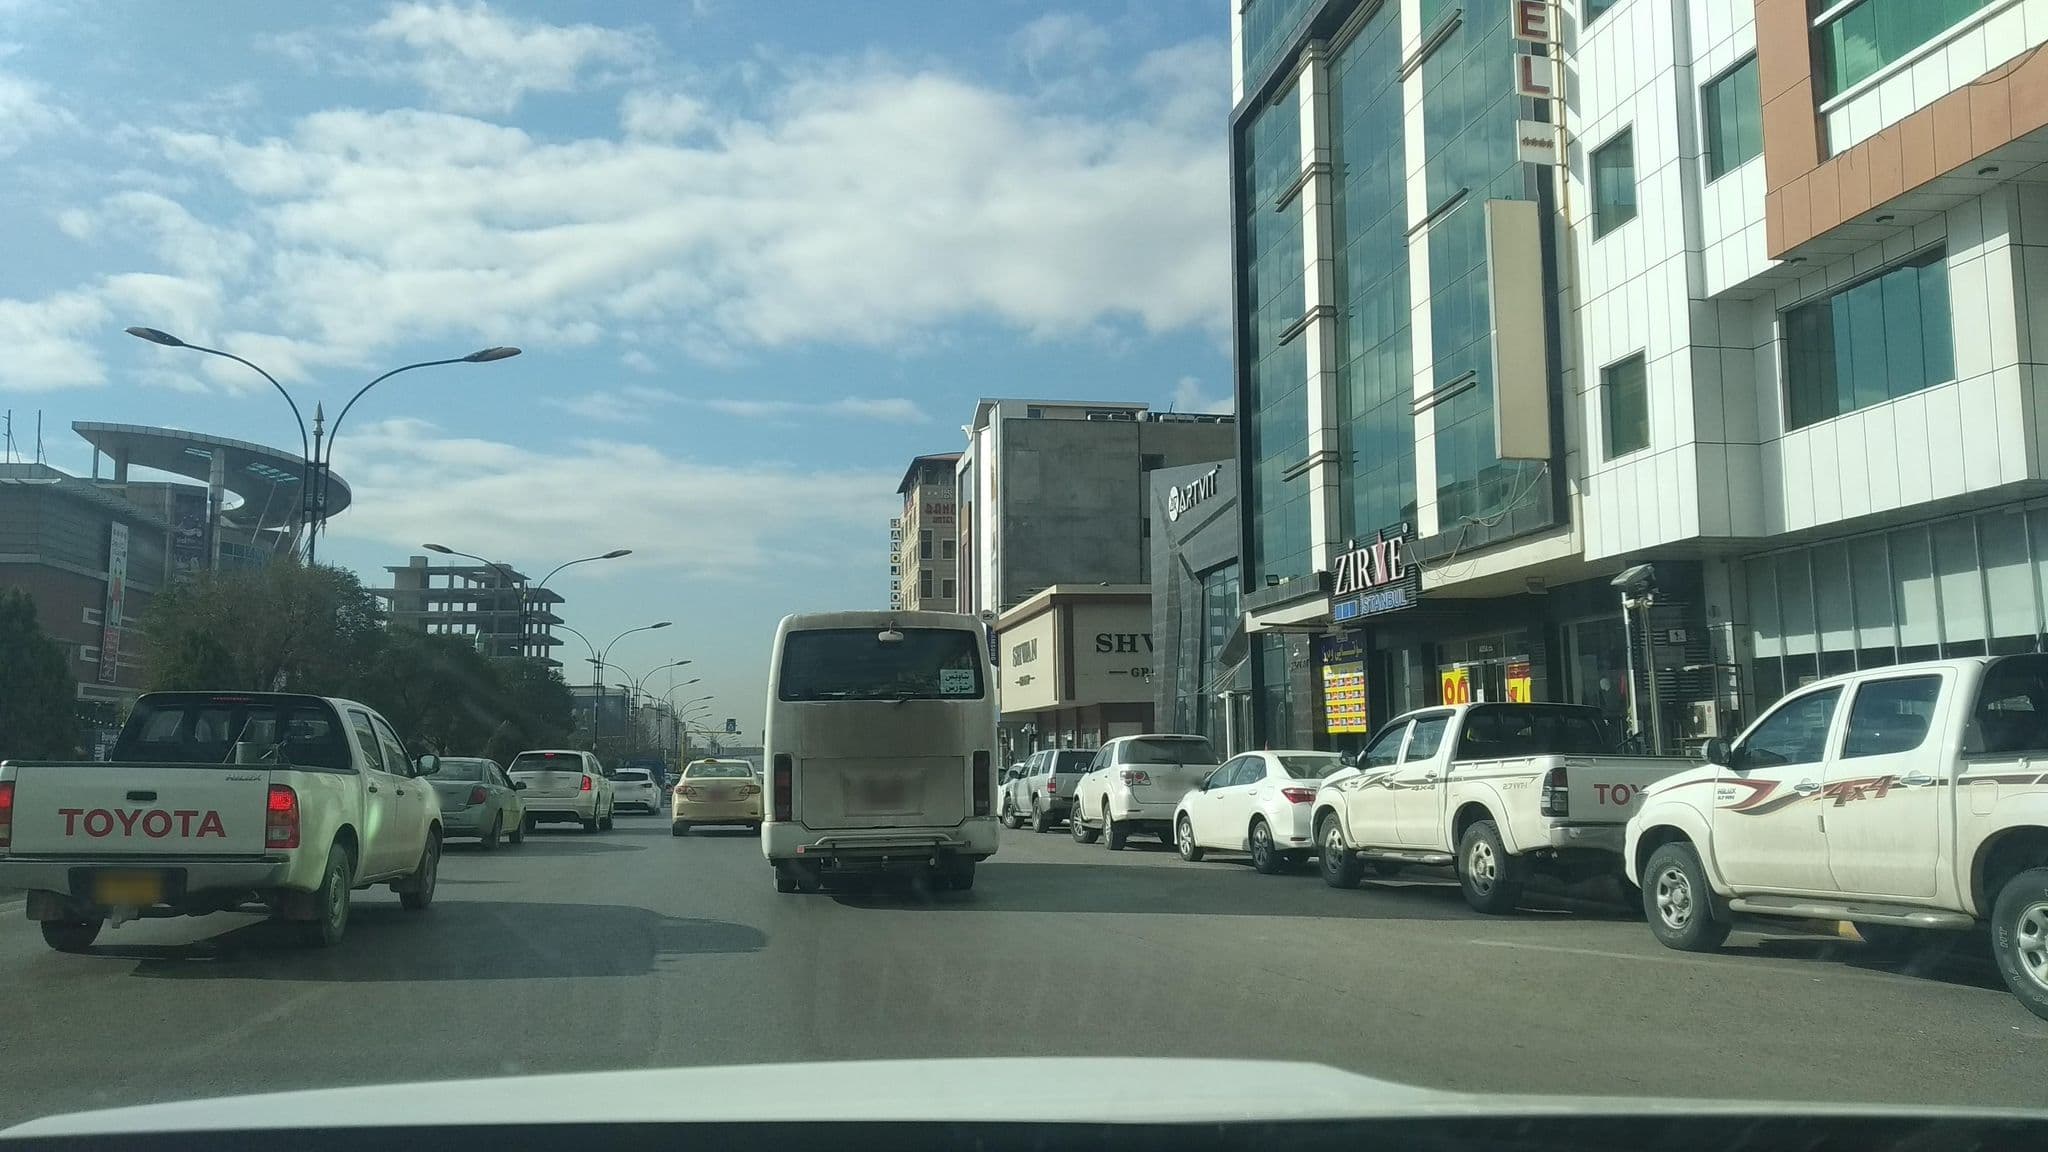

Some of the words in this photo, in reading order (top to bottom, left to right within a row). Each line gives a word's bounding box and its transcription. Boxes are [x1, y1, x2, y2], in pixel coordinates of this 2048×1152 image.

[1179, 469, 1216, 513] ARTVIT
[890, 519, 901, 576] BANOJ
[58, 808, 226, 838] TOYOTA
